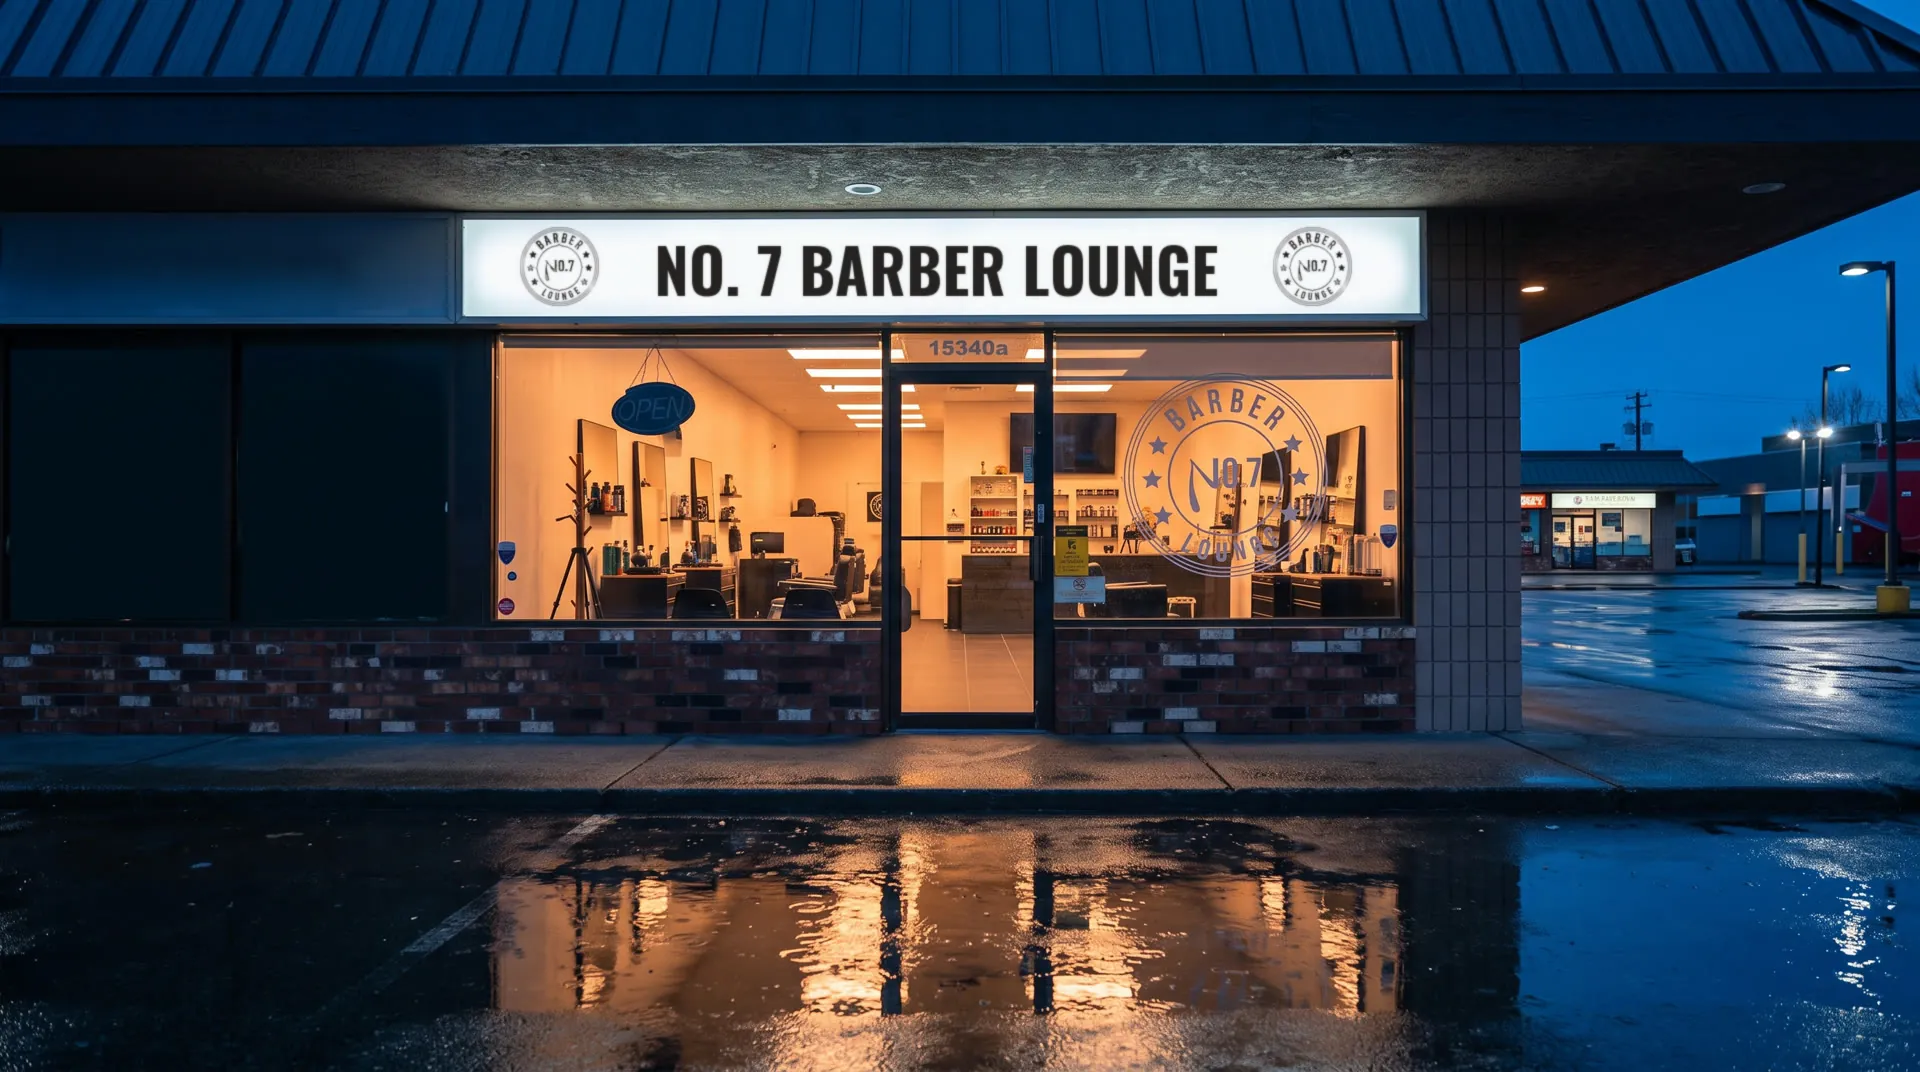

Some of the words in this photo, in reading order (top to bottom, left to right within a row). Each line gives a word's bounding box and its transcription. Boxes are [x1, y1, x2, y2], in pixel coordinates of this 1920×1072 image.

[535, 232, 584, 250] BARBER
[1288, 232, 1337, 250] BARBER
[544, 259, 575, 281] NO.7
[657, 244, 739, 298] NO.
[757, 245, 782, 297] 7
[802, 244, 1005, 298] BARBER
[1025, 244, 1218, 298] LOUNGE
[1297, 259, 1328, 281] NO.7
[541, 286, 581, 301] LOUNGE
[1294, 286, 1334, 301] LOUNGE
[929, 339, 1008, 356] 15340a
[617, 395, 687, 422] OPEN
[1163, 387, 1286, 432] BARBER
